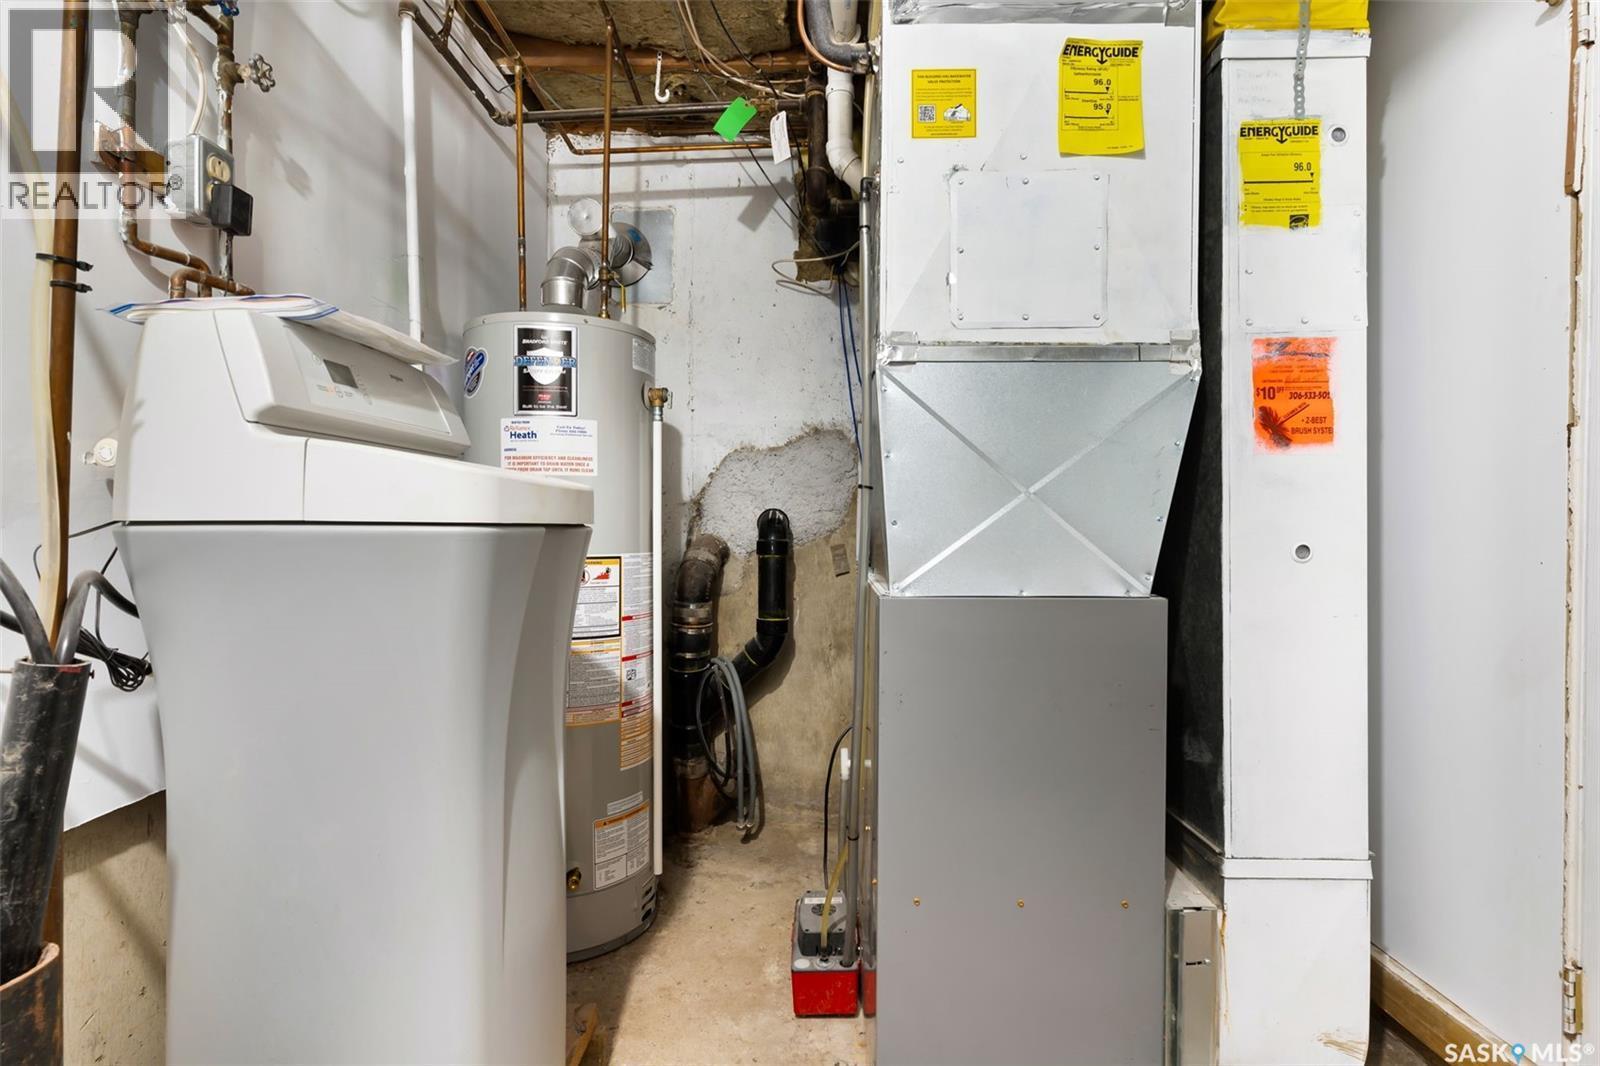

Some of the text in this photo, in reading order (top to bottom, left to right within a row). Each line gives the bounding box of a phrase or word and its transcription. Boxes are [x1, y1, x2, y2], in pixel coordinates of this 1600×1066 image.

[1063, 44, 1139, 62] ENERGYGUIDE
[1240, 126, 1319, 142] ENERGYGUIDE
[1294, 162, 1312, 172] 96.0
[510, 431, 537, 439] Heath
